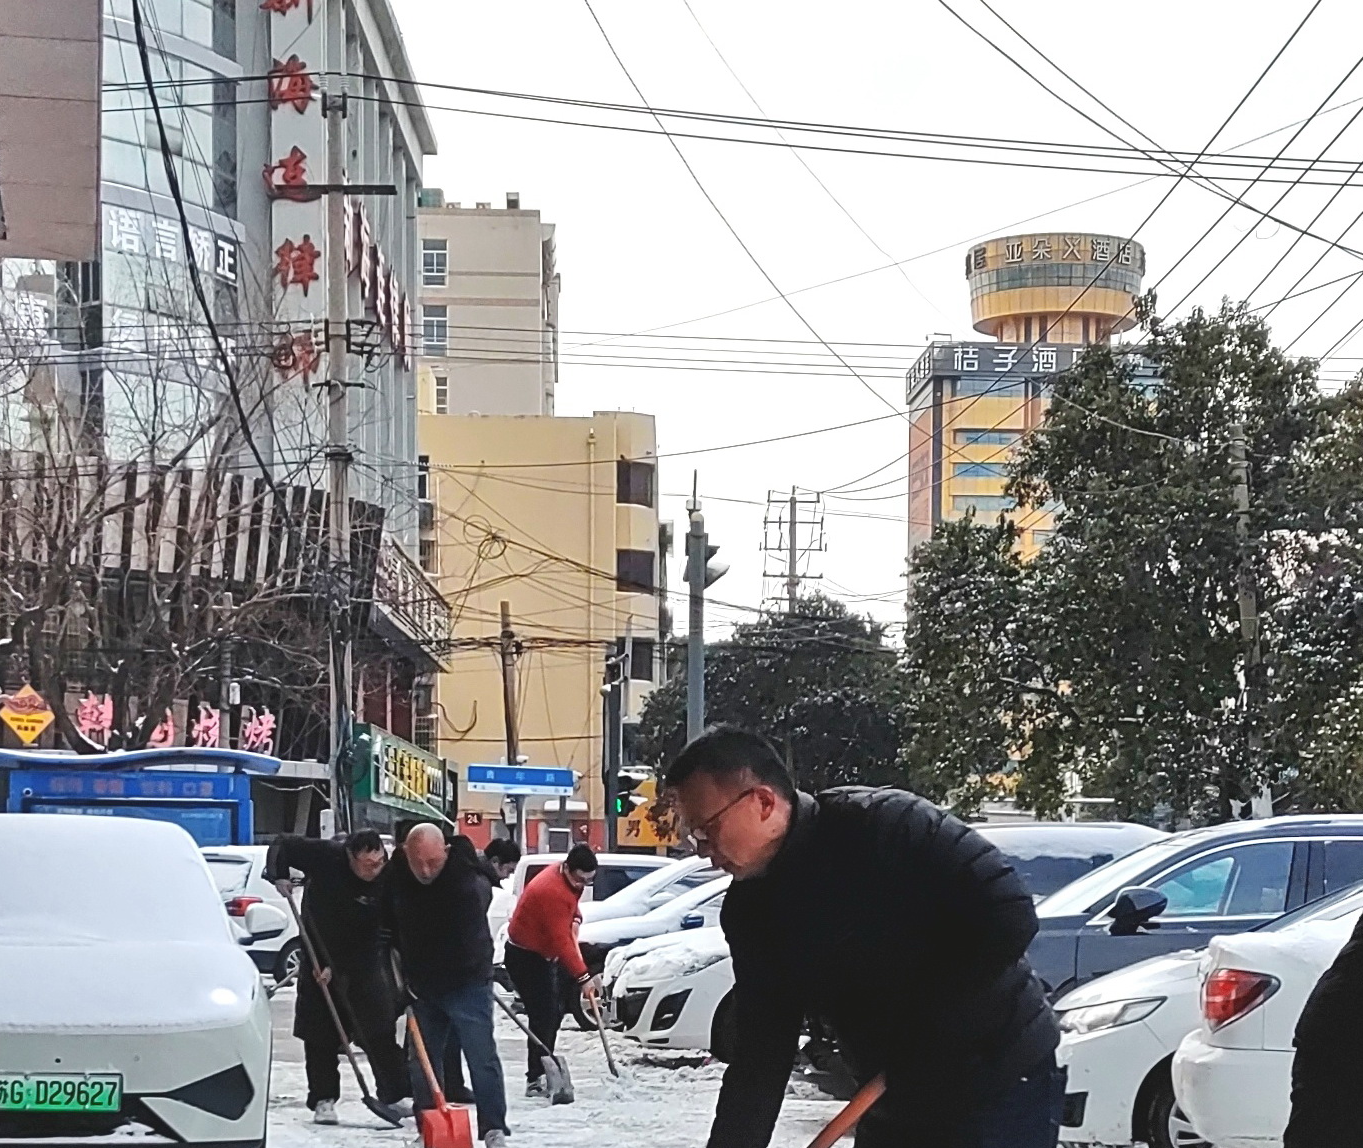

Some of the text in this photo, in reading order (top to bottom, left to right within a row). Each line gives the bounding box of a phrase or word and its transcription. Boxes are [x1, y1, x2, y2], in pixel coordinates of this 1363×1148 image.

[108, 209, 236, 280] 语言矫正
[467, 814, 479, 824] 24
